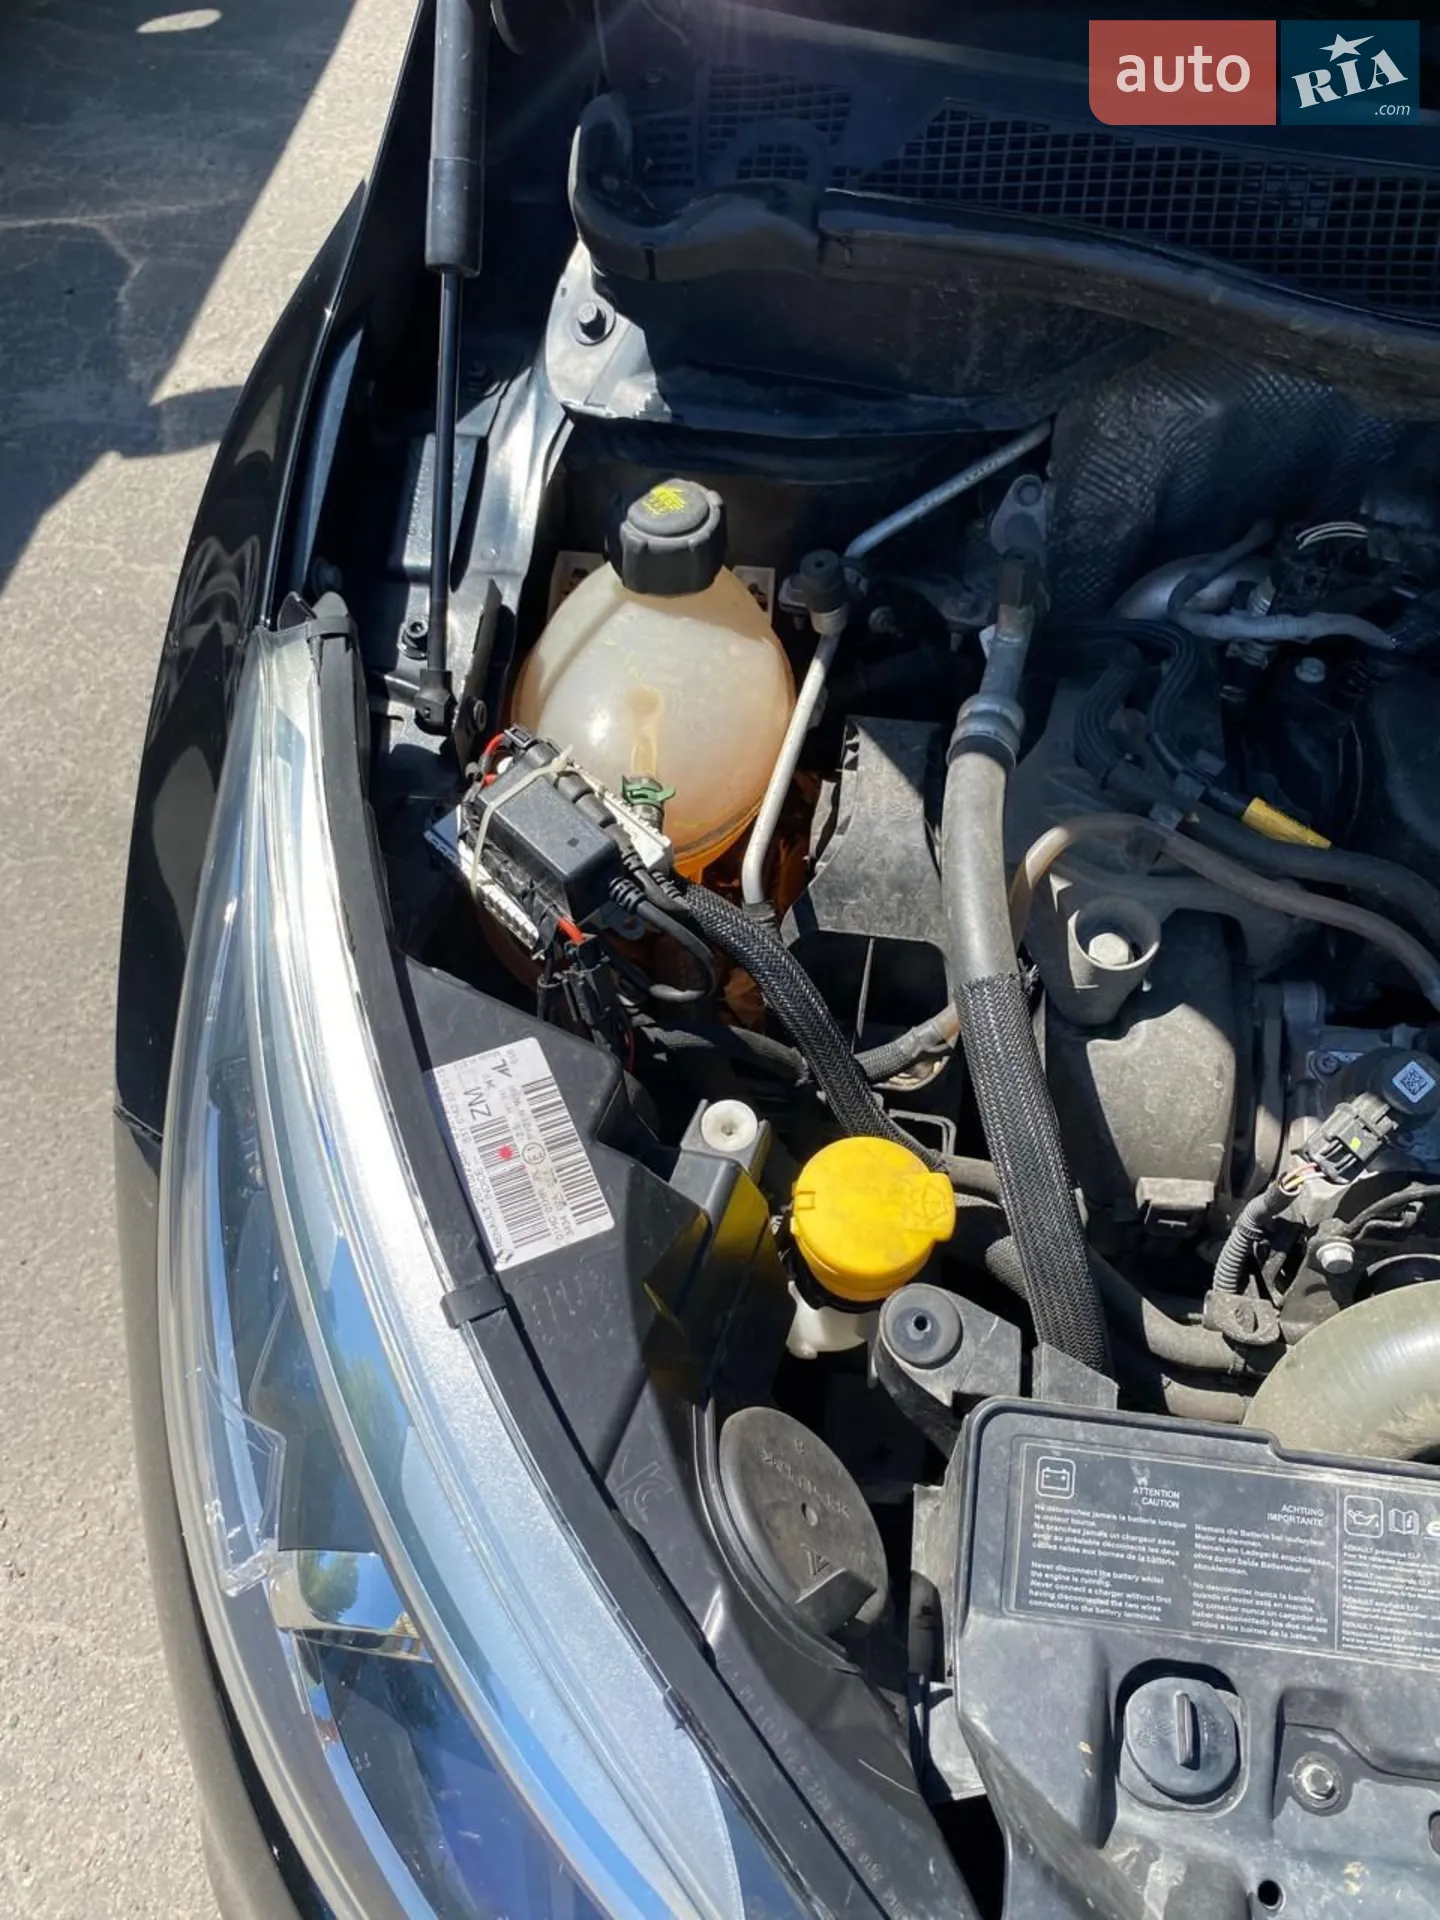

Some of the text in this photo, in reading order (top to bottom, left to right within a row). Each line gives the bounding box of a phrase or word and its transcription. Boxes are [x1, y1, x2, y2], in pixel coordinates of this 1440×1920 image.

[463, 1086, 491, 1120] ZM
[1132, 1486, 1180, 1499] ATTENTION
[1141, 1496, 1180, 1510] CAUTION
[1281, 1503, 1324, 1517] ACHTUNG
